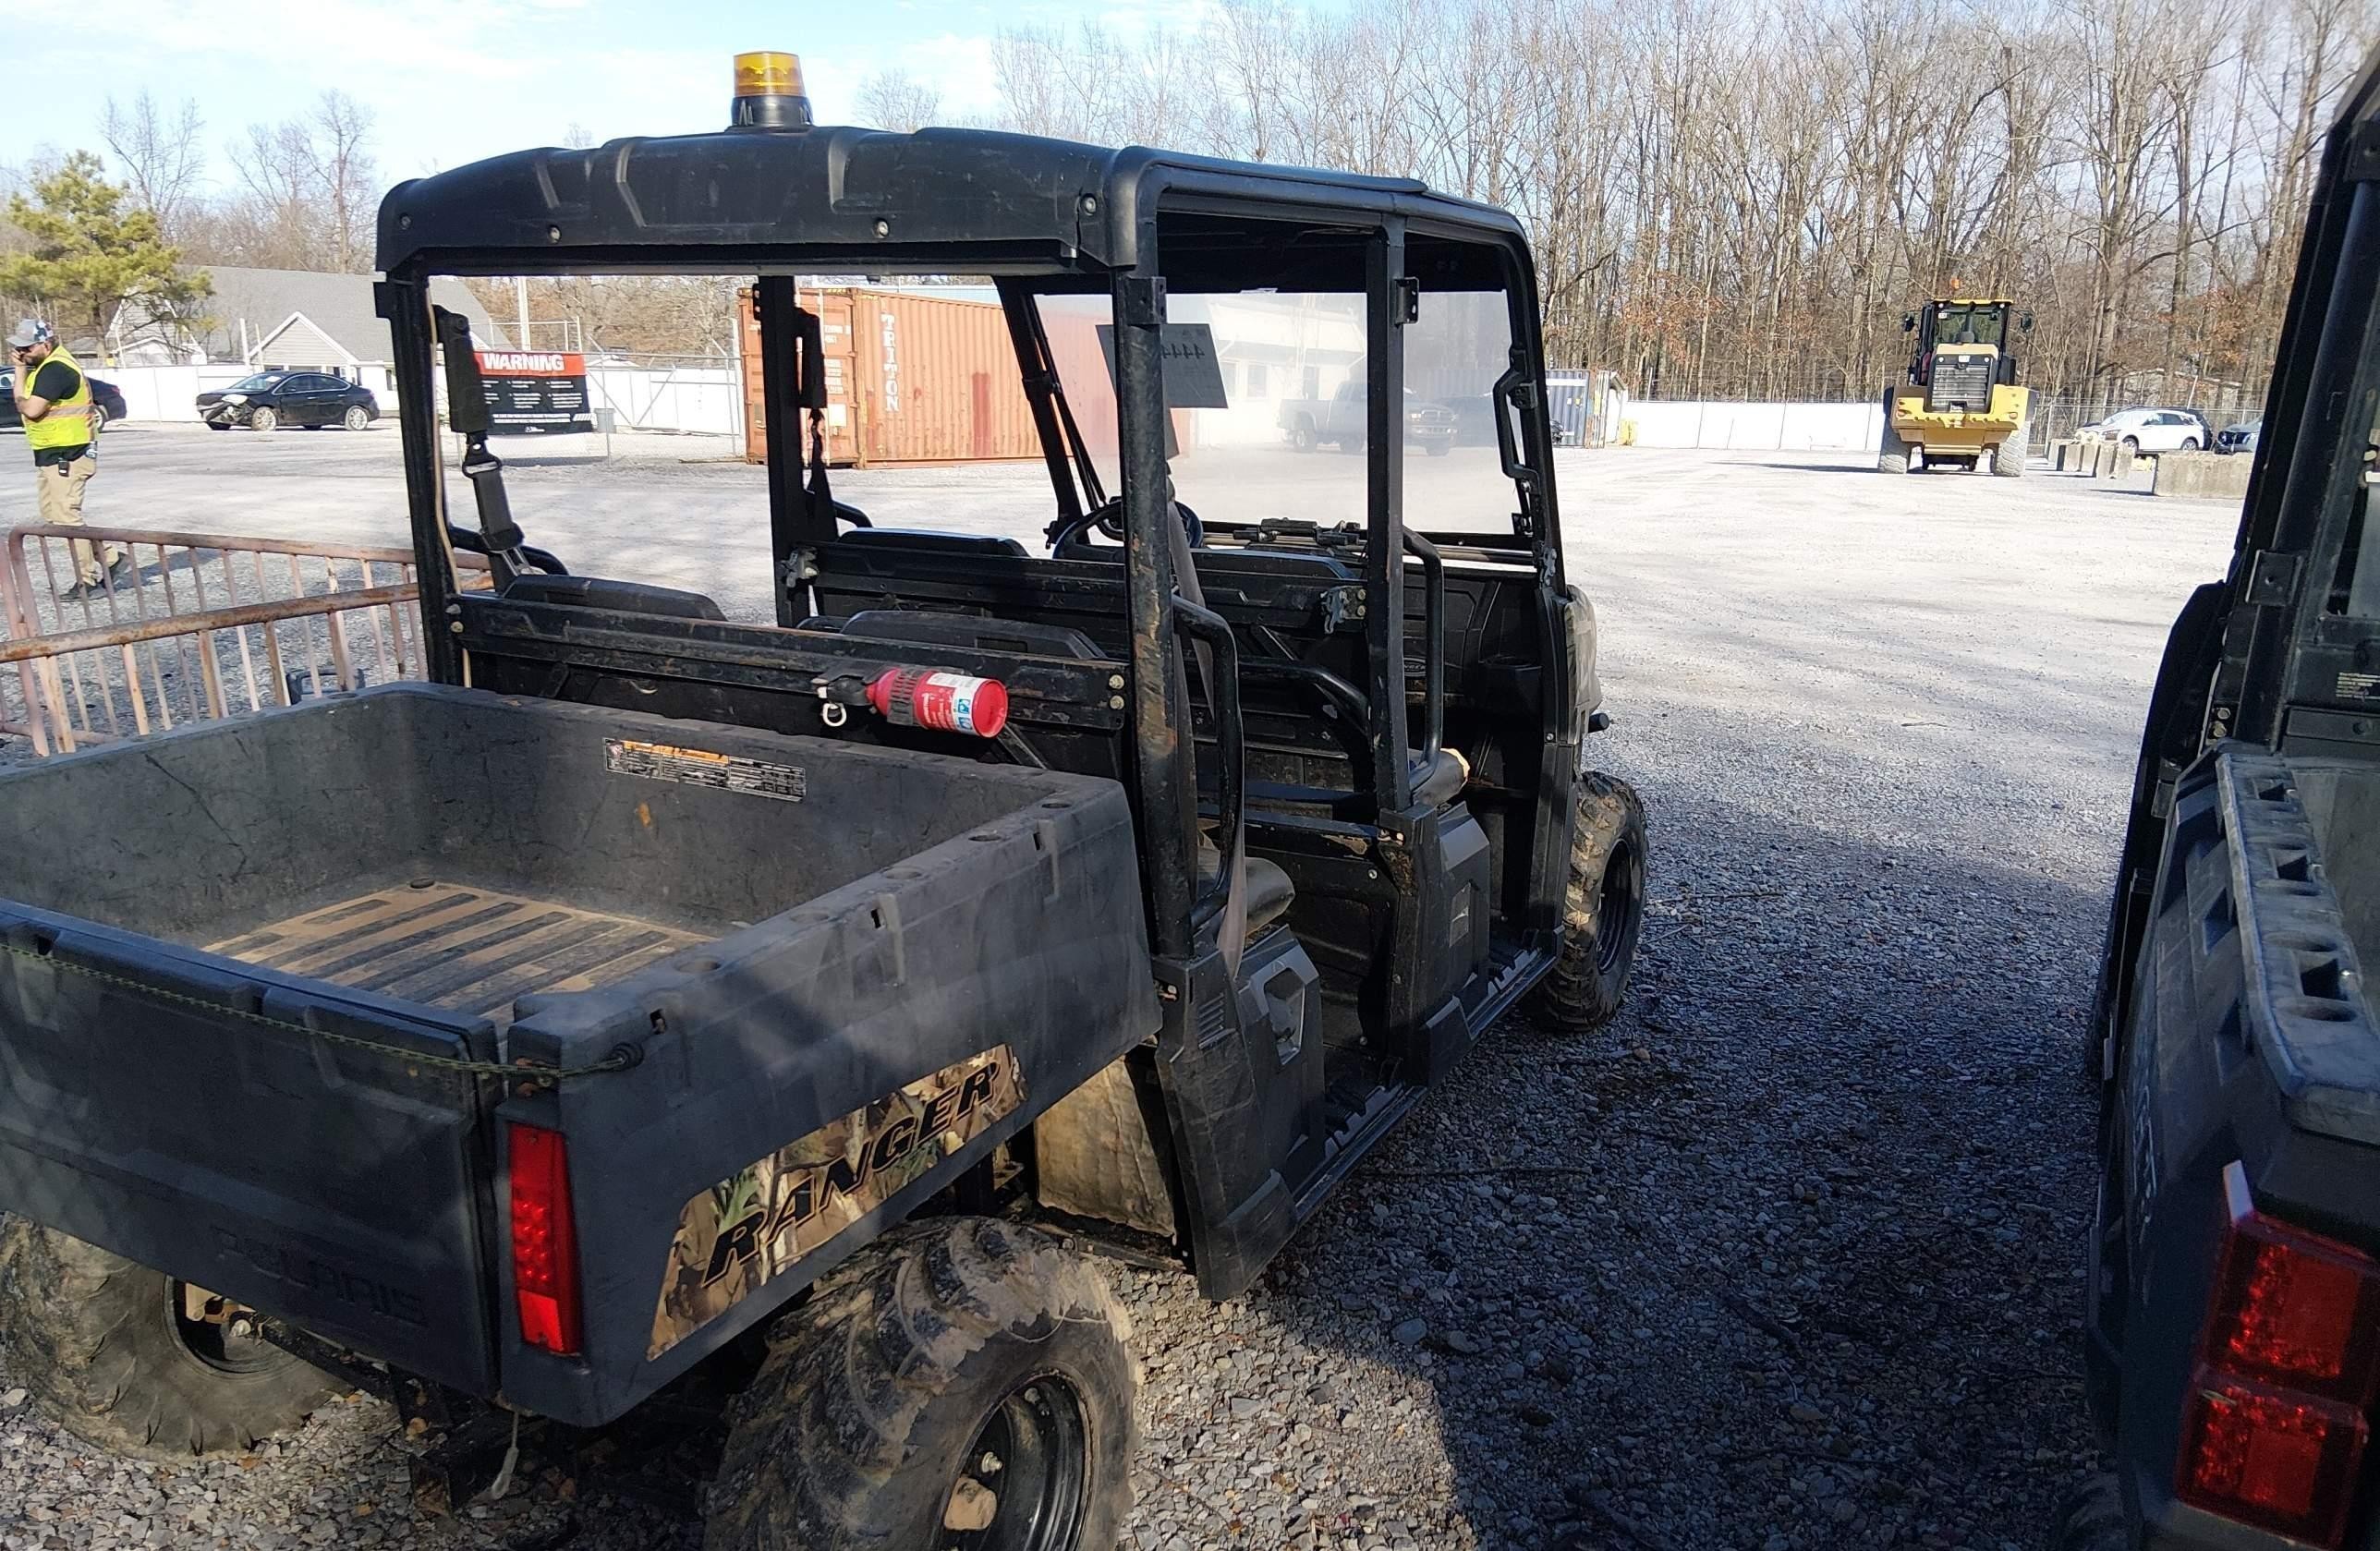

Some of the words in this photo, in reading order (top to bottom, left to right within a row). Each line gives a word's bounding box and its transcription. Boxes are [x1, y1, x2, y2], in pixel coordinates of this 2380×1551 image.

[483, 353, 565, 371] WARNING
[880, 313, 900, 412] TRITON
[700, 1061, 1000, 1289] RANGER
